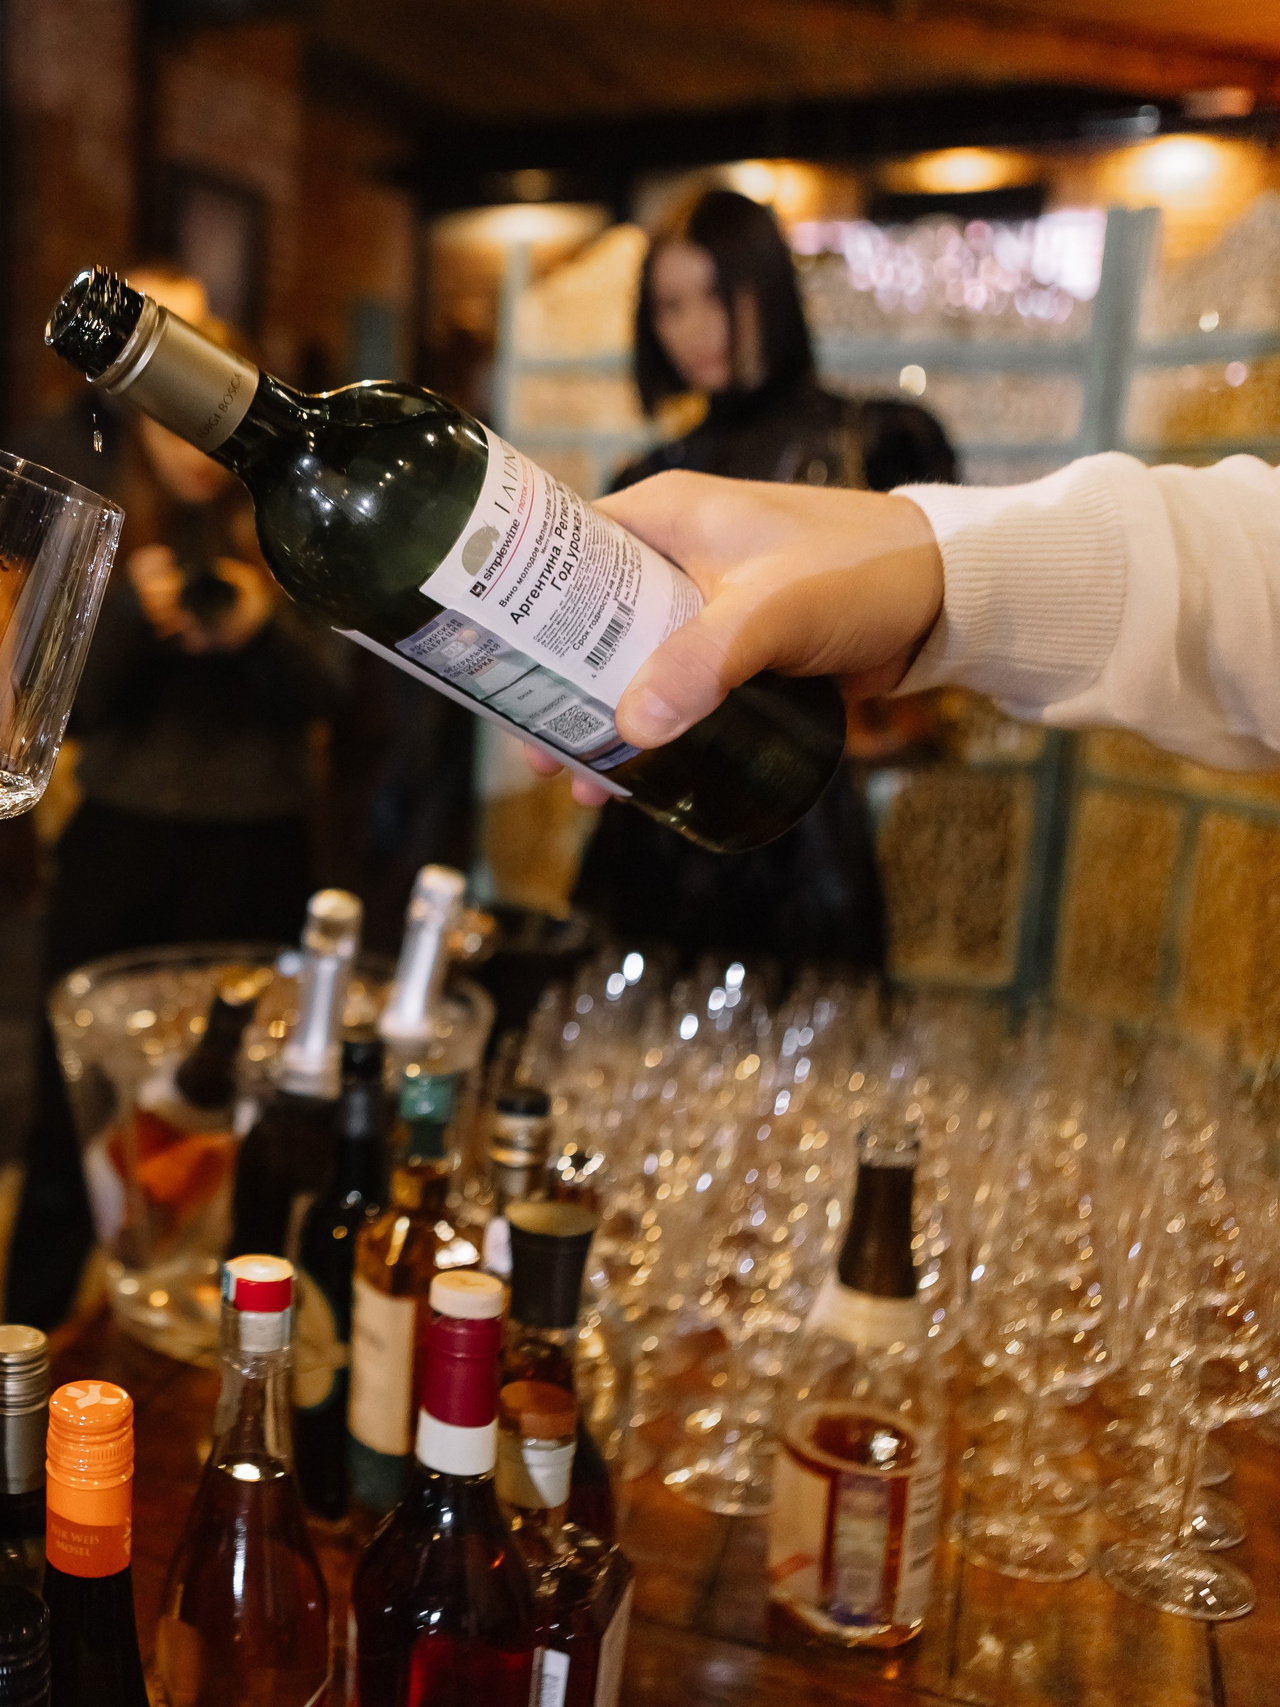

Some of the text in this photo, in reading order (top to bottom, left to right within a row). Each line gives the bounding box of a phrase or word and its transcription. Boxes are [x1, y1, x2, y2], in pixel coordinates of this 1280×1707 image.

[217, 371, 242, 412] BOSCA
[482, 518, 521, 582] simplewine
[498, 585, 519, 608] Вино
[516, 546, 540, 585] молодое
[534, 520, 549, 546] белое
[543, 497, 552, 519] сухое
[511, 545, 564, 625] Аргентина.
[553, 496, 572, 540] Регион
[550, 560, 574, 591] Год
[566, 509, 583, 561] урожая
[409, 617, 459, 652] РОССИЙСКАЯ
[571, 629, 591, 652] Срок
[587, 591, 612, 630] годности
[608, 579, 616, 590] не
[415, 621, 464, 657] ФЕДЕРАЦИЯ
[443, 638, 495, 674] ФЕДЕРАЛЬНАЯ
[449, 643, 501, 679] СПЕЦИАЛЬНАЯ
[467, 657, 495, 677] МАРКА
